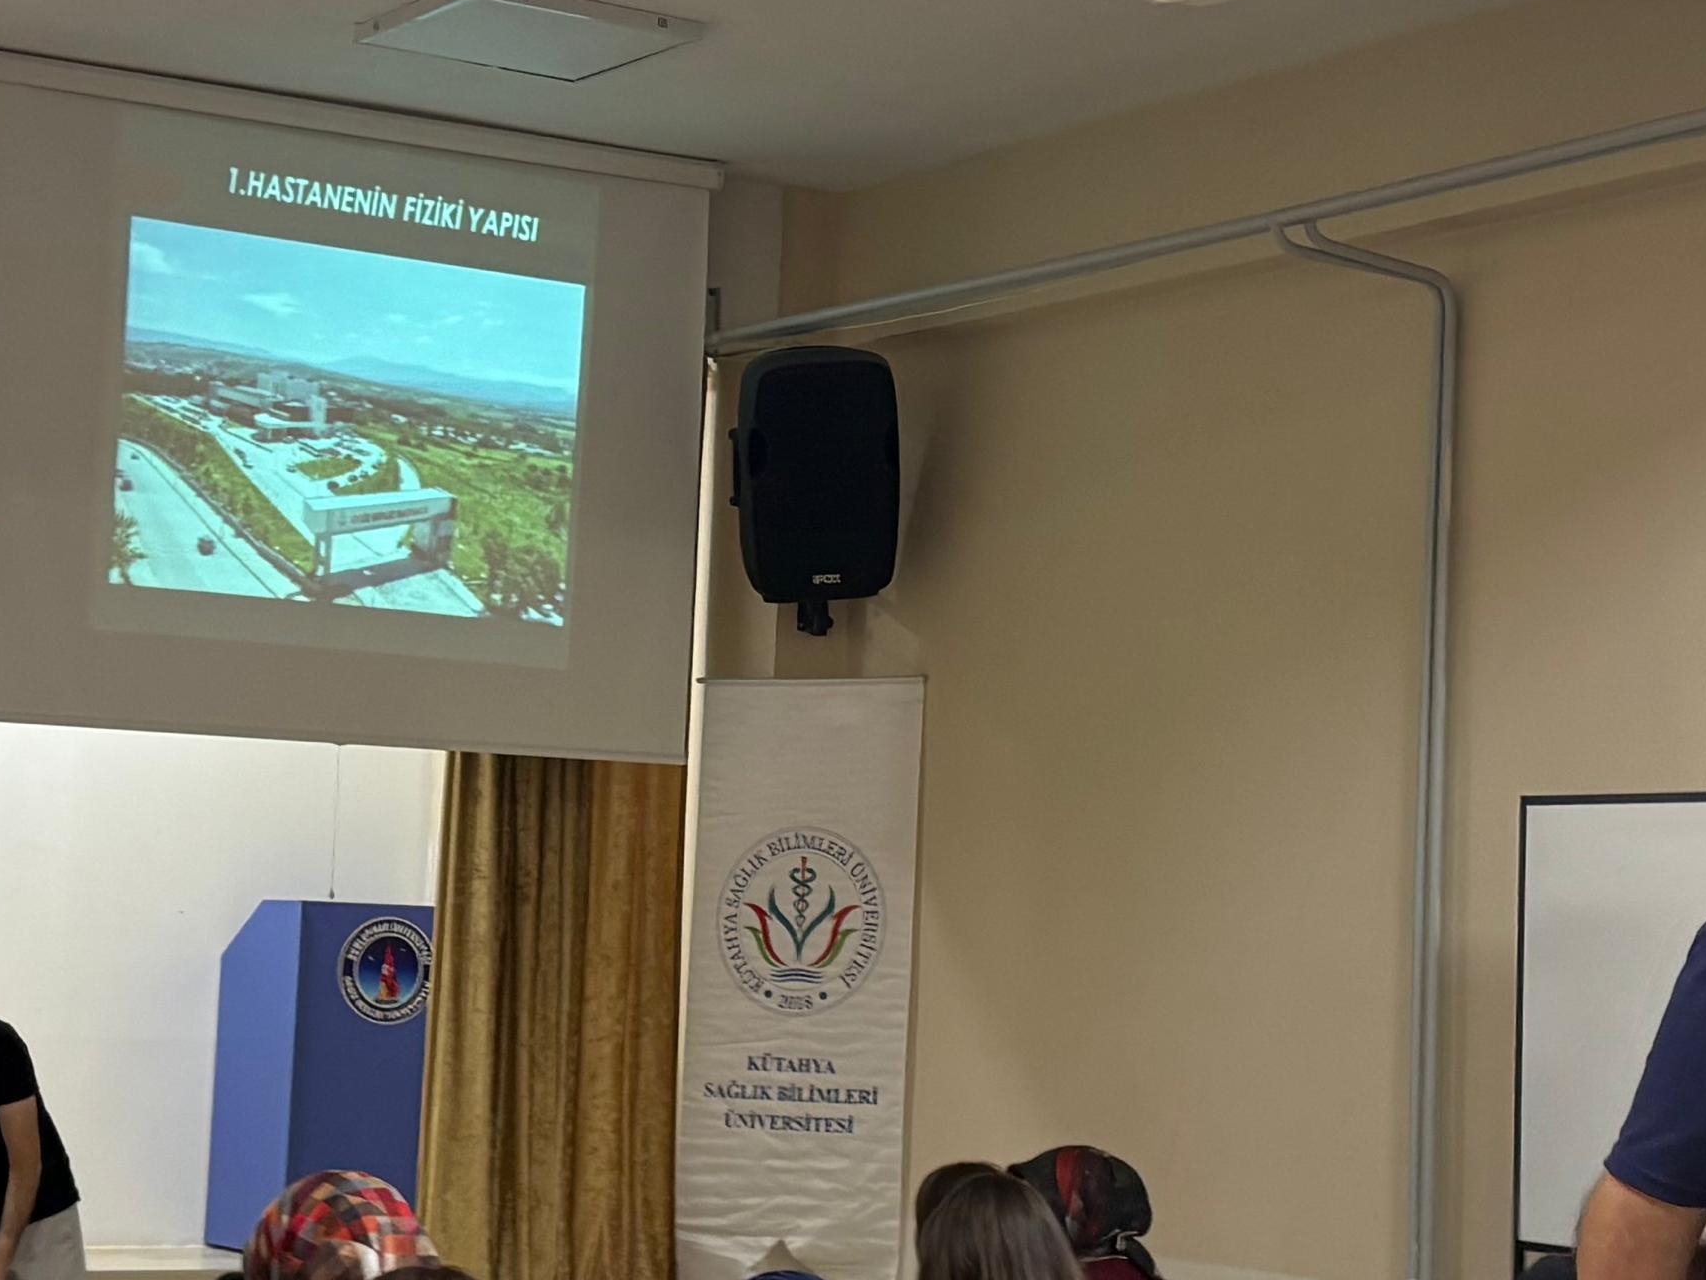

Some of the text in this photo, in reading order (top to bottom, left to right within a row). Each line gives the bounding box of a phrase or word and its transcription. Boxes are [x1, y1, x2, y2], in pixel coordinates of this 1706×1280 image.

[228, 166, 540, 242] 1.HASTANENİN FİZİKİ YAPISI
[747, 1053, 836, 1074] KÜTAHYA
[703, 1080, 879, 1105] SAĞLIK BİLİMLERİ
[724, 1109, 854, 1134] ÜNİVERSİTESİ
